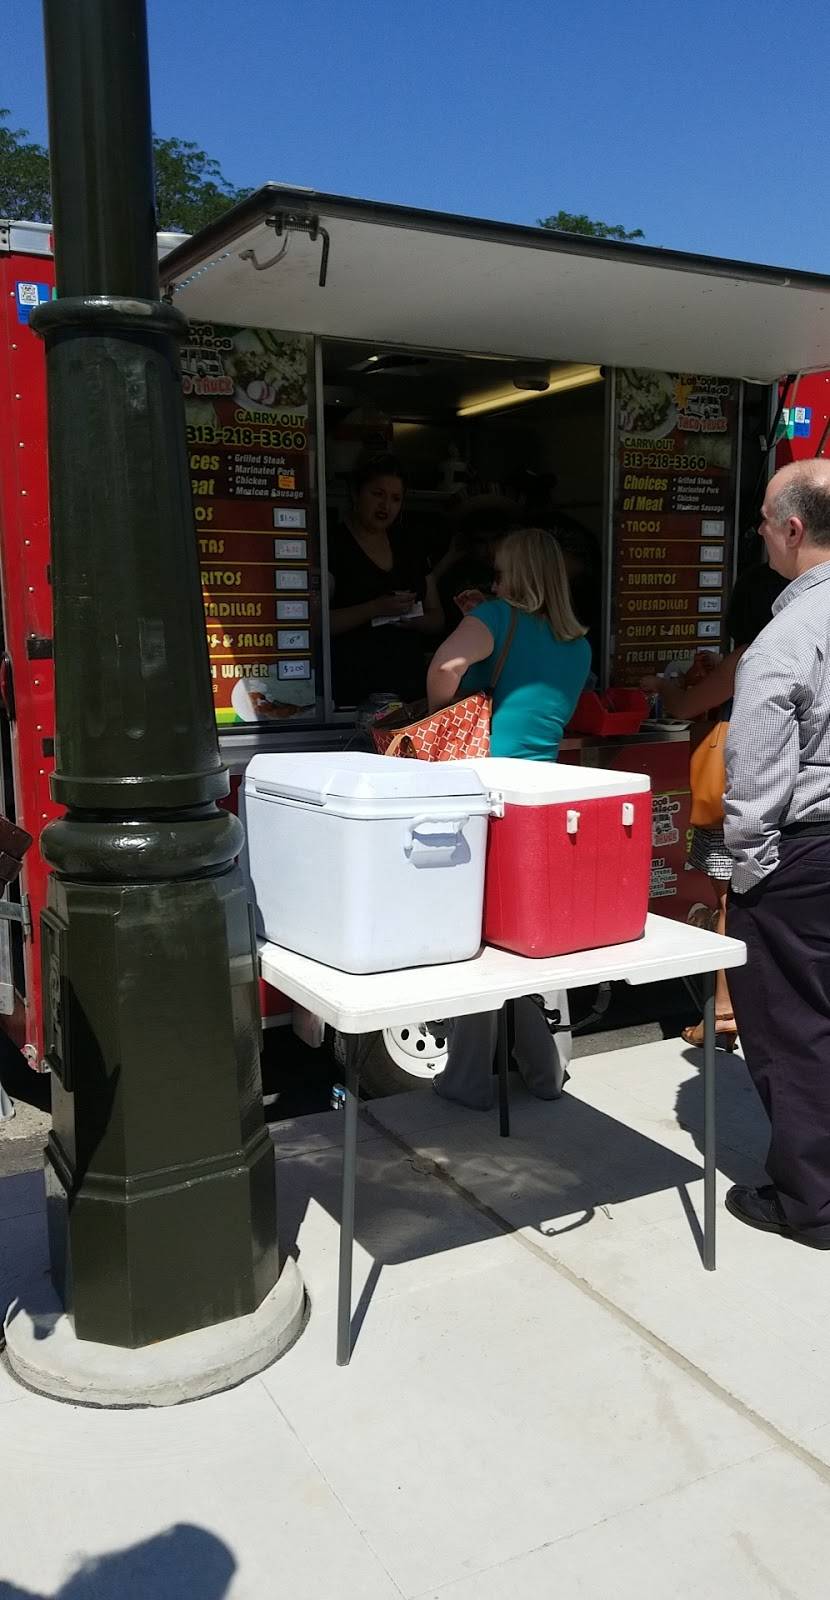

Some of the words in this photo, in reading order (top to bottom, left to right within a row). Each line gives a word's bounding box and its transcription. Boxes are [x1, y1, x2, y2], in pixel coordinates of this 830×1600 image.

[235, 411, 277, 426] CARRY
[280, 414, 305, 427] OUT
[186, 425, 306, 450] 313-218-3360
[624, 438, 654, 449] CARRY
[656, 440, 674, 450] OUT
[235, 454, 261, 463] Grilled
[263, 456, 286, 465] Steak
[624, 452, 706, 472] 313-218-3360
[235, 465, 275, 476] Marinated
[235, 476, 267, 486] Chicken
[623, 475, 668, 491] Choices
[235, 486, 269, 497] Mexican
[271, 488, 304, 499] Sausage
[623, 496, 635, 511] of
[636, 496, 664, 512] Meat
[626, 520, 661, 533] TACOS
[629, 546, 667, 559] TORTAS
[628, 573, 677, 585] BURRITOS
[628, 599, 689, 611] QUESADILLAS
[627, 625, 656, 637] CHIPS
[237, 633, 274, 647] SALSA
[626, 650, 656, 663] FRESH
[657, 648, 690, 661] WATER
[221, 663, 269, 678] WATER
